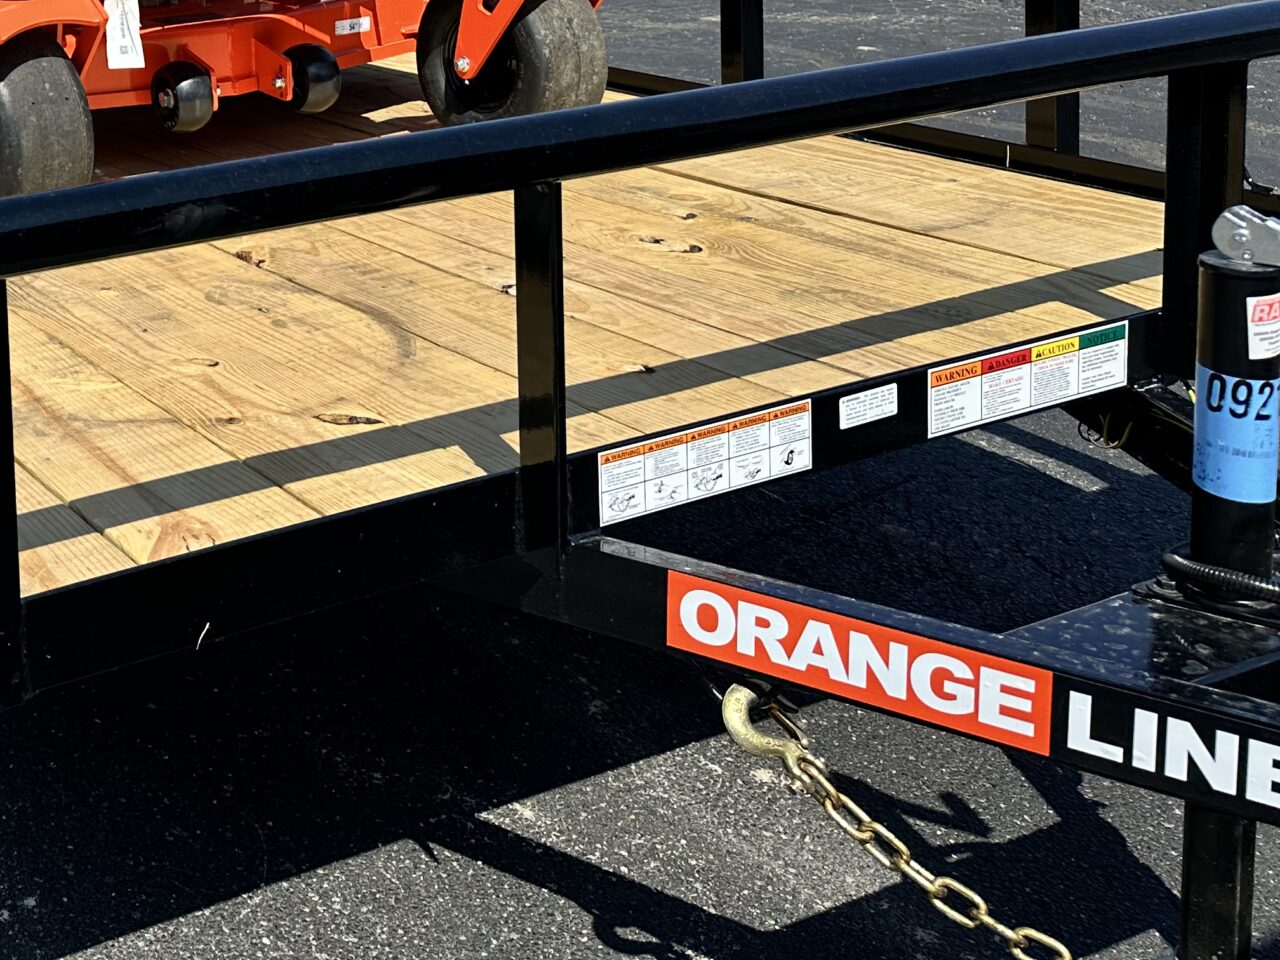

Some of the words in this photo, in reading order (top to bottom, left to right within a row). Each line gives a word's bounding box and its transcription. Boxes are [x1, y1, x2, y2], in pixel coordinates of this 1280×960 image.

[1253, 302, 1280, 322] RA
[1087, 331, 1118, 345] NOTICE
[1042, 341, 1075, 356] CAUTION
[995, 354, 1027, 368] DANGER
[935, 365, 978, 383] WARNING
[1206, 373, 1280, 421] 092
[780, 405, 807, 417] WARNING
[740, 415, 767, 427] WARNING
[697, 426, 726, 438] WARNING
[654, 437, 684, 449] WARNING
[610, 448, 641, 461] WARNING
[679, 589, 1035, 738] ORANGE
[1067, 690, 1280, 810] LINE
